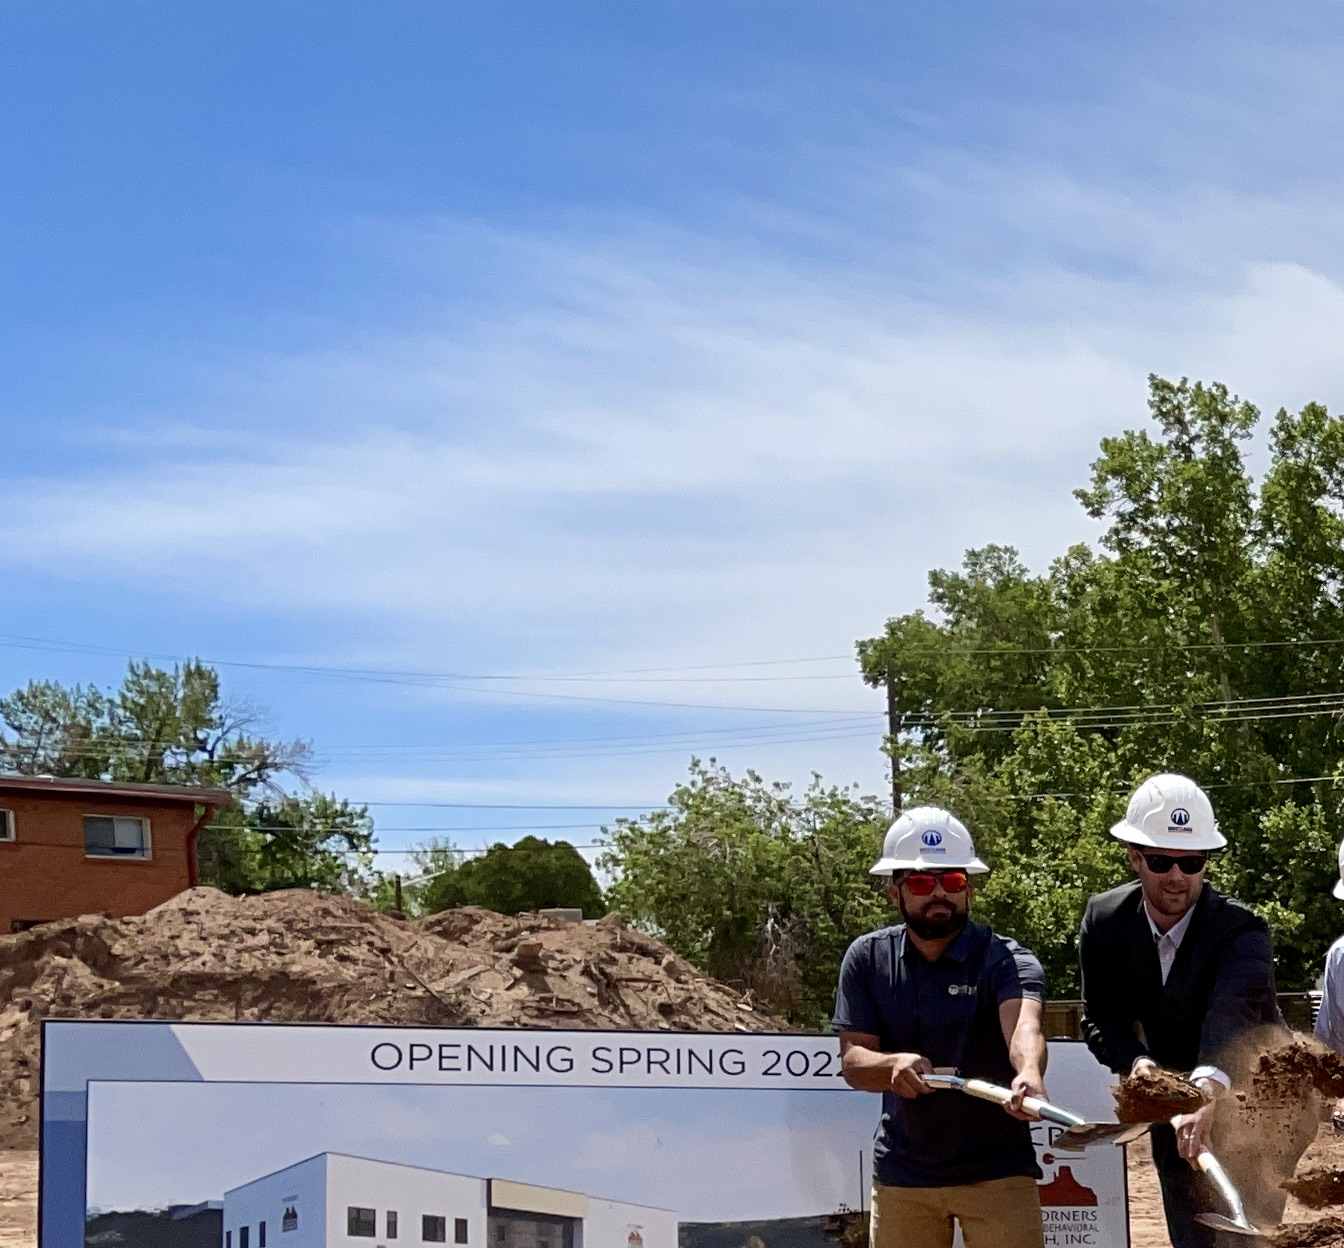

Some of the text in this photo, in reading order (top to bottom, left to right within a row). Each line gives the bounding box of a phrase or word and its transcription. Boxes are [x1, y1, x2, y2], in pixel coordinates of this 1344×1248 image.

[371, 1042, 844, 1078] OPENING SPRING 202
